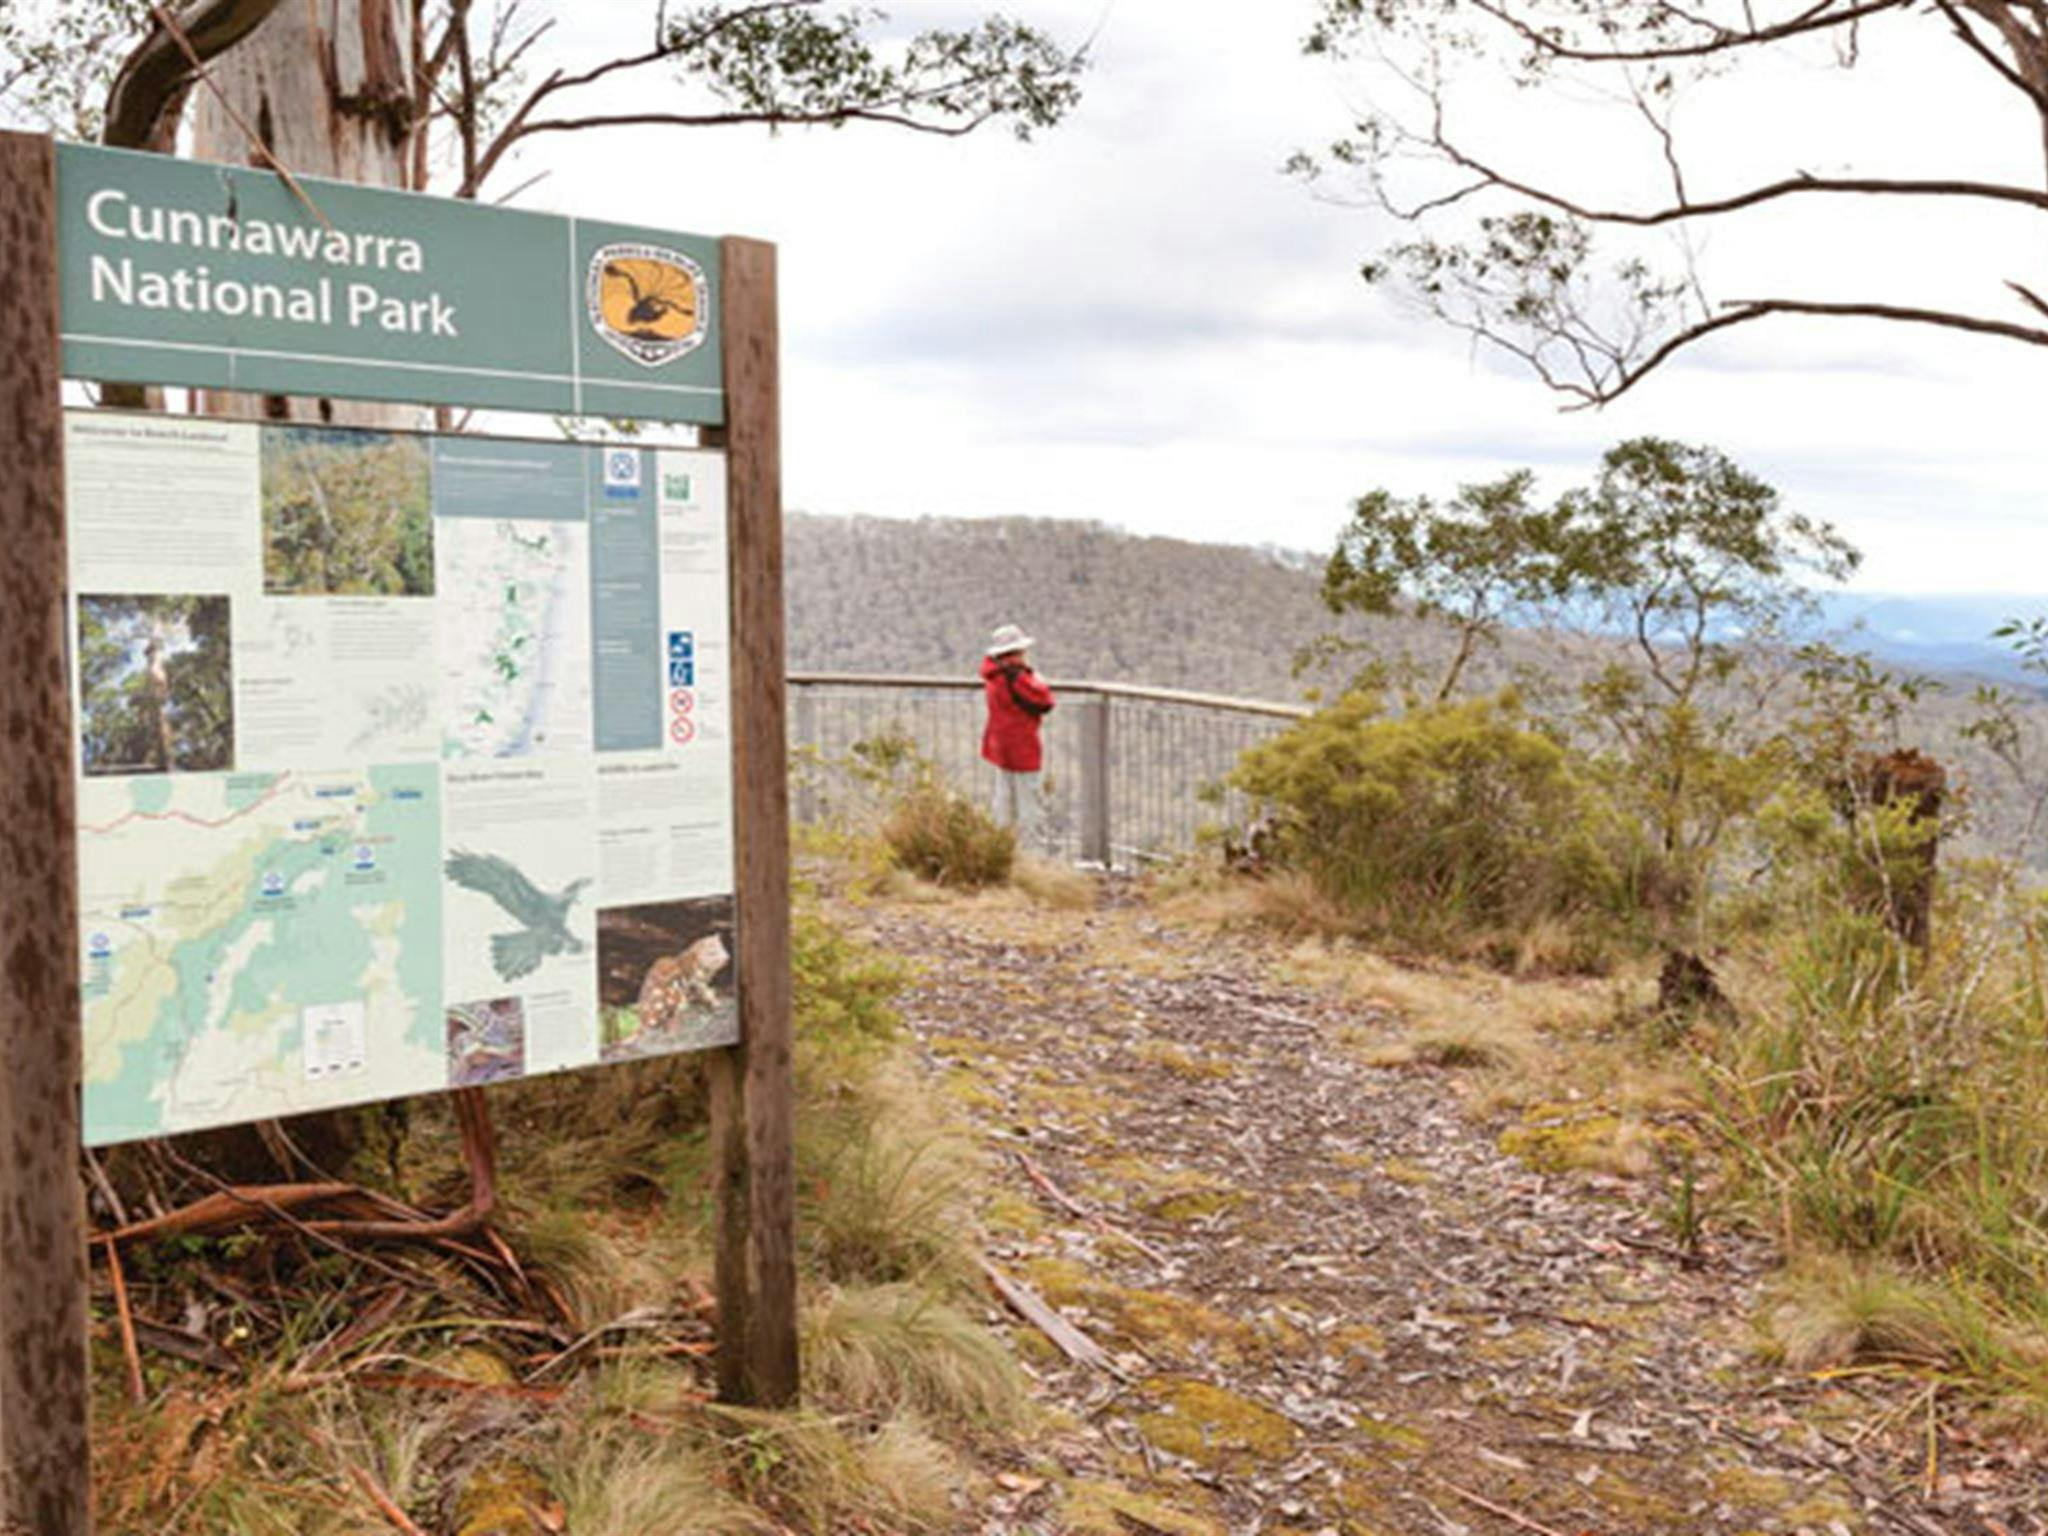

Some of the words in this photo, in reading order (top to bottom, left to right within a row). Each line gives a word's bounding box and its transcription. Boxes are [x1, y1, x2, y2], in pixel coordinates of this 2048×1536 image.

[86, 189, 424, 272] Cunnawarra
[91, 255, 330, 323] National
[348, 284, 458, 336] Park
